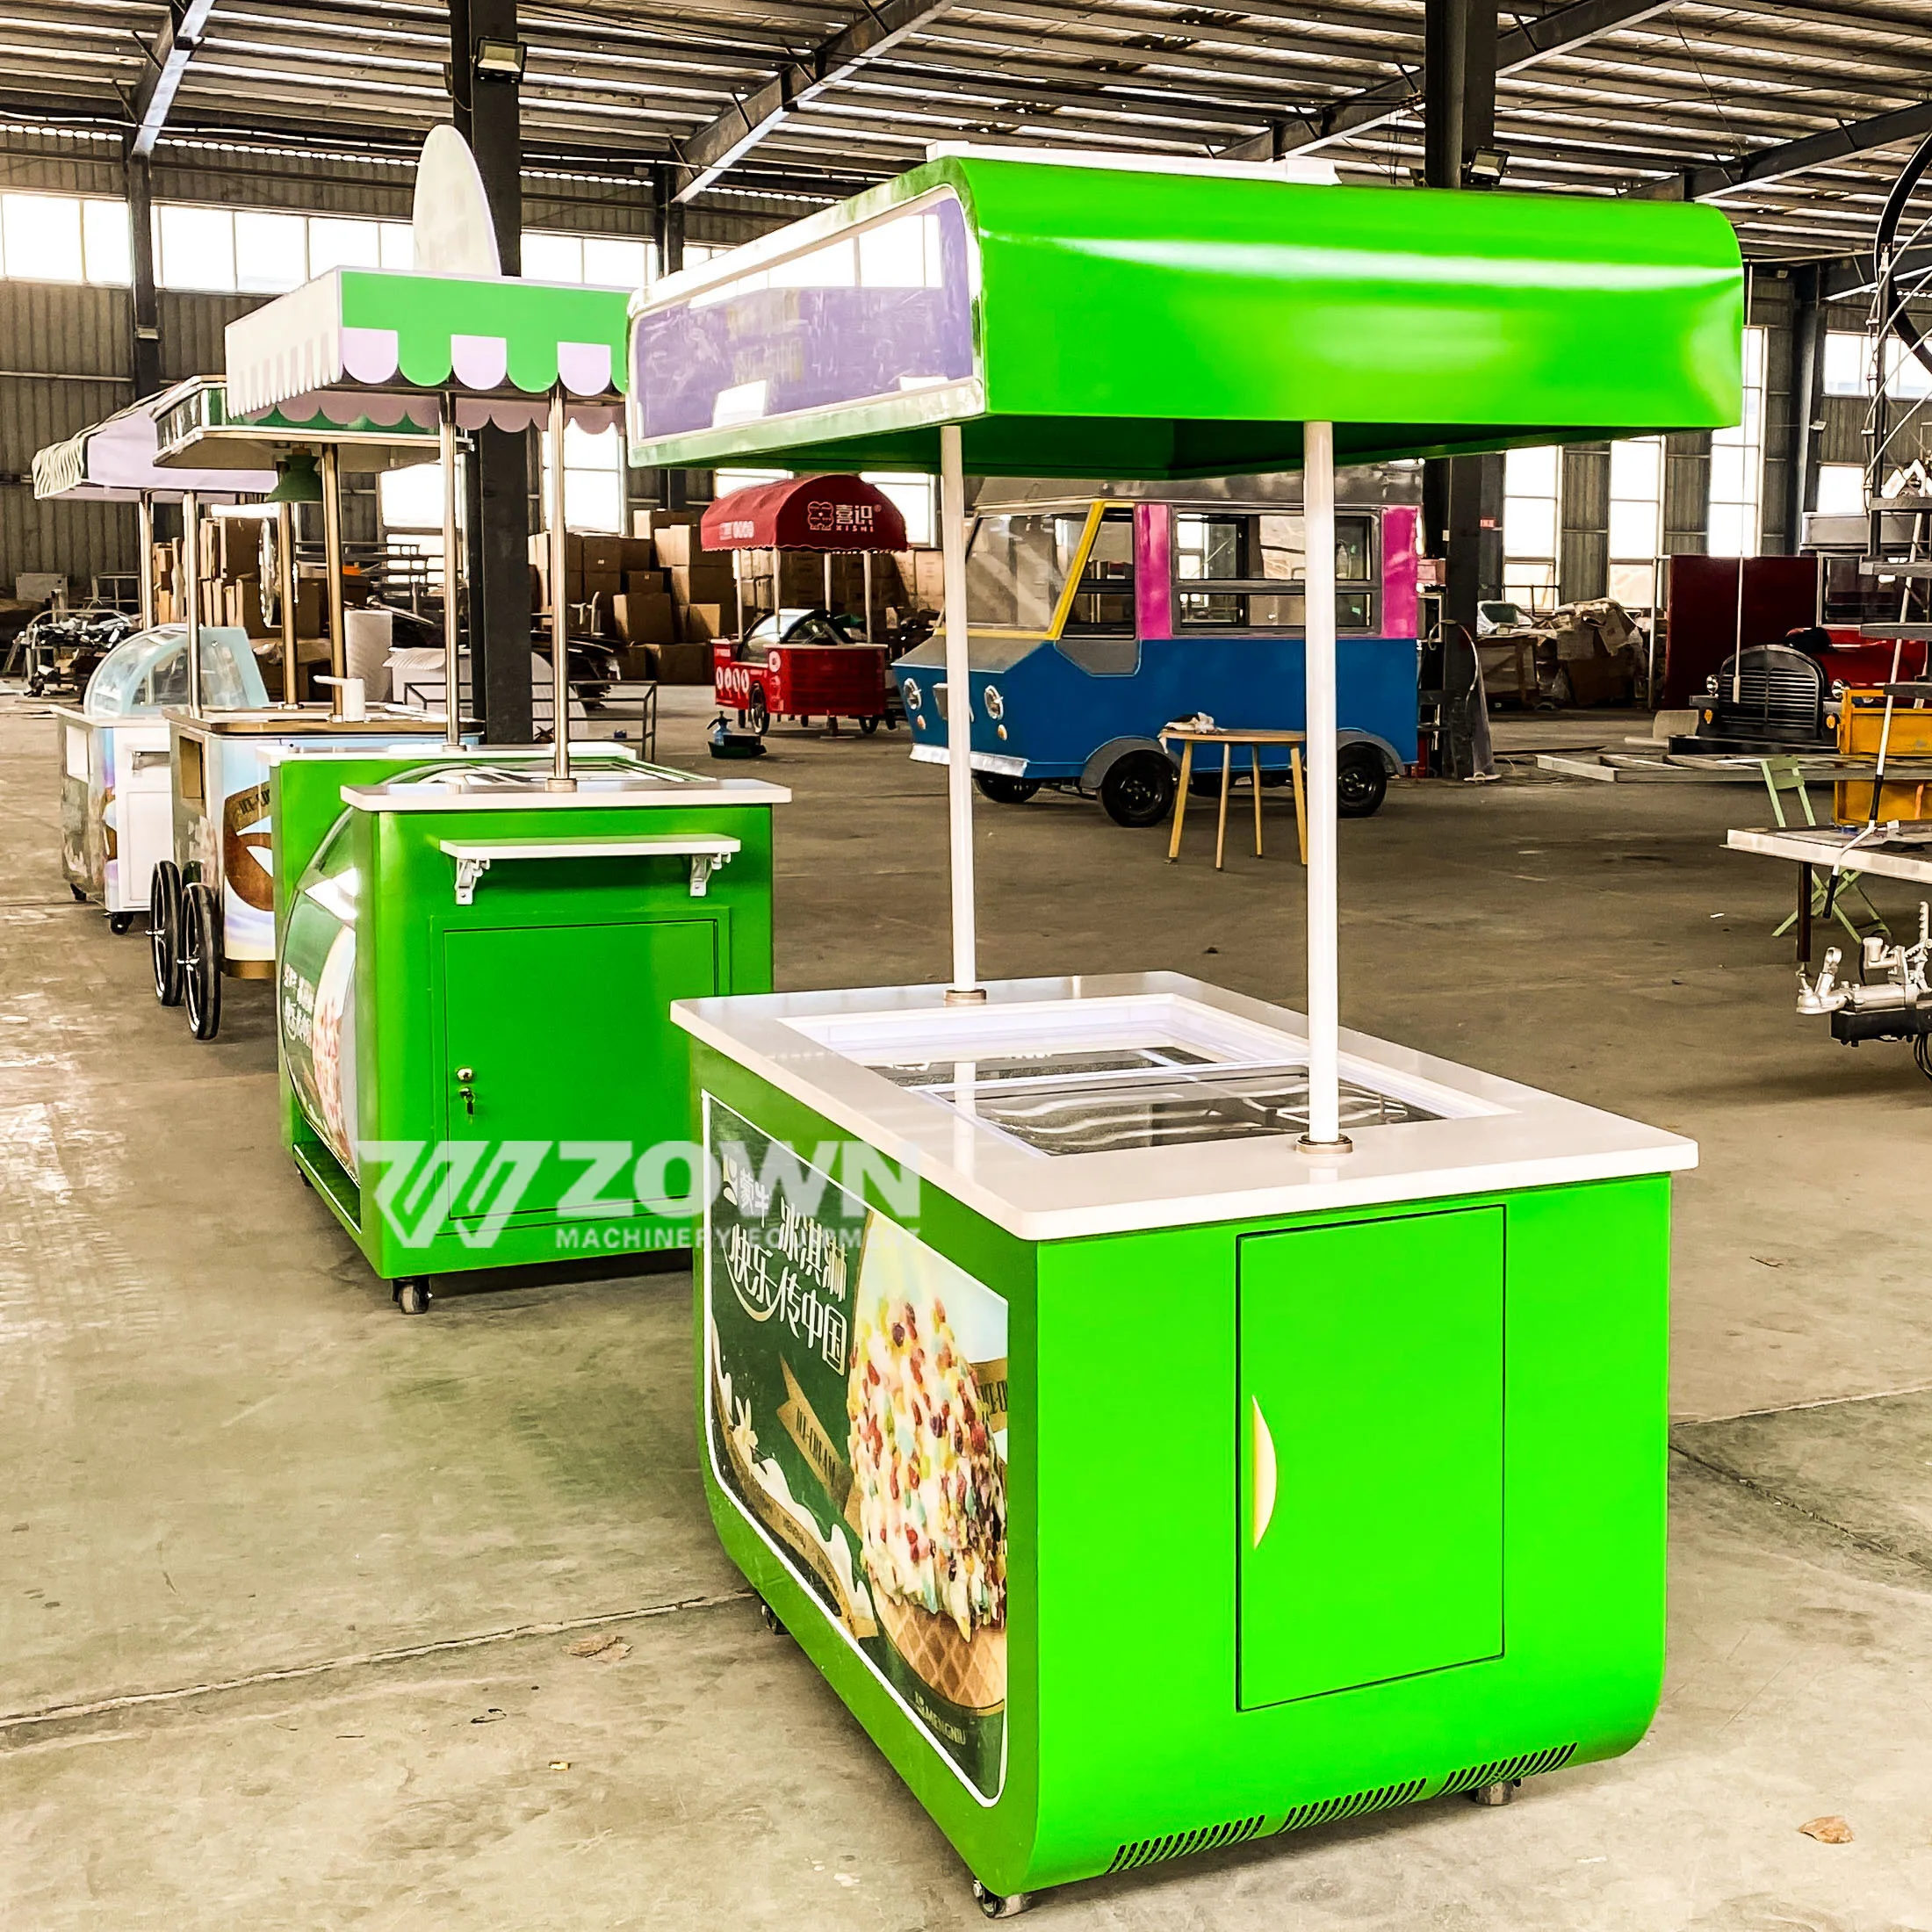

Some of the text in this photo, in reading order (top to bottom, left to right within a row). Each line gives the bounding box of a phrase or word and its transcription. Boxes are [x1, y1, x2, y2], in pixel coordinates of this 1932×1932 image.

[727, 1222, 847, 1377] 快乐传中国
